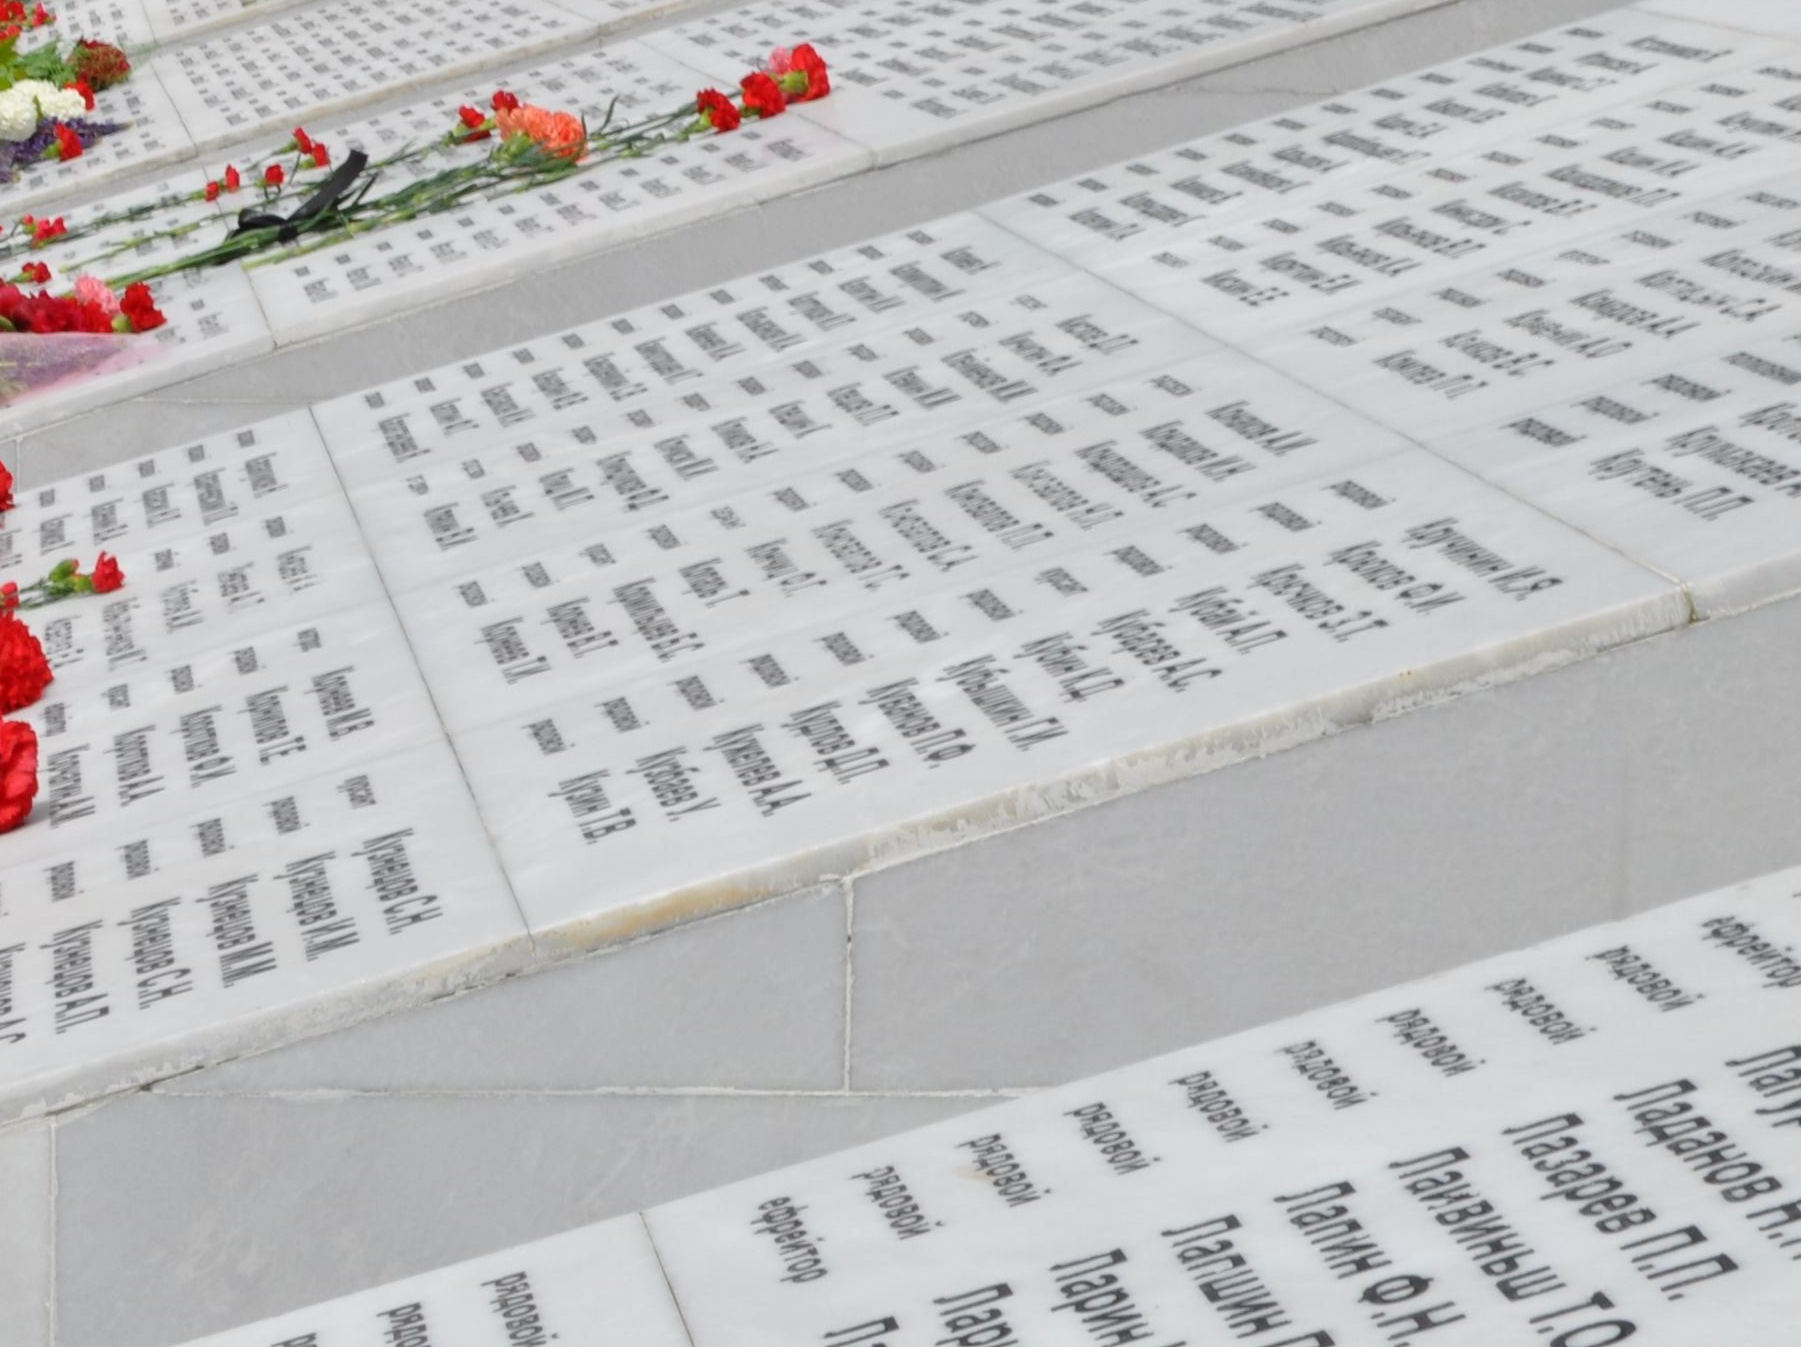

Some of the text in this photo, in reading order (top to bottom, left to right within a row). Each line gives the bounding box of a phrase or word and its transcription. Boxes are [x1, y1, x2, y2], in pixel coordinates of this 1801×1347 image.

[273, 850, 338, 927] Кузнецов
[350, 827, 419, 903] Кузнецов
[117, 896, 181, 975] Кузнецов
[195, 873, 259, 951] Кузнецов
[300, 916, 361, 962] И.М.
[382, 894, 443, 936] С.Н.
[39, 919, 104, 999] Кузнецов
[136, 967, 193, 1011] С.Н.
[219, 940, 278, 989] М.М.
[1591, 944, 1705, 1013] рядовой
[55, 992, 110, 1035] А.П.
[1279, 1040, 1379, 1111] рядовой
[1484, 977, 1597, 1046] рядовой
[1612, 1078, 1780, 1203] Ладанов
[957, 1133, 1052, 1208] рядовой
[1168, 1070, 1270, 1143] рядовой
[1272, 1180, 1393, 1280] Лапин
[1375, 1007, 1740, 1301] рядовой Лазарев П.П.
[750, 1196, 829, 1284] ефрейтор
[851, 1165, 944, 1241] рядовой
[1063, 1101, 1291, 1334] рядовой Лапшин
